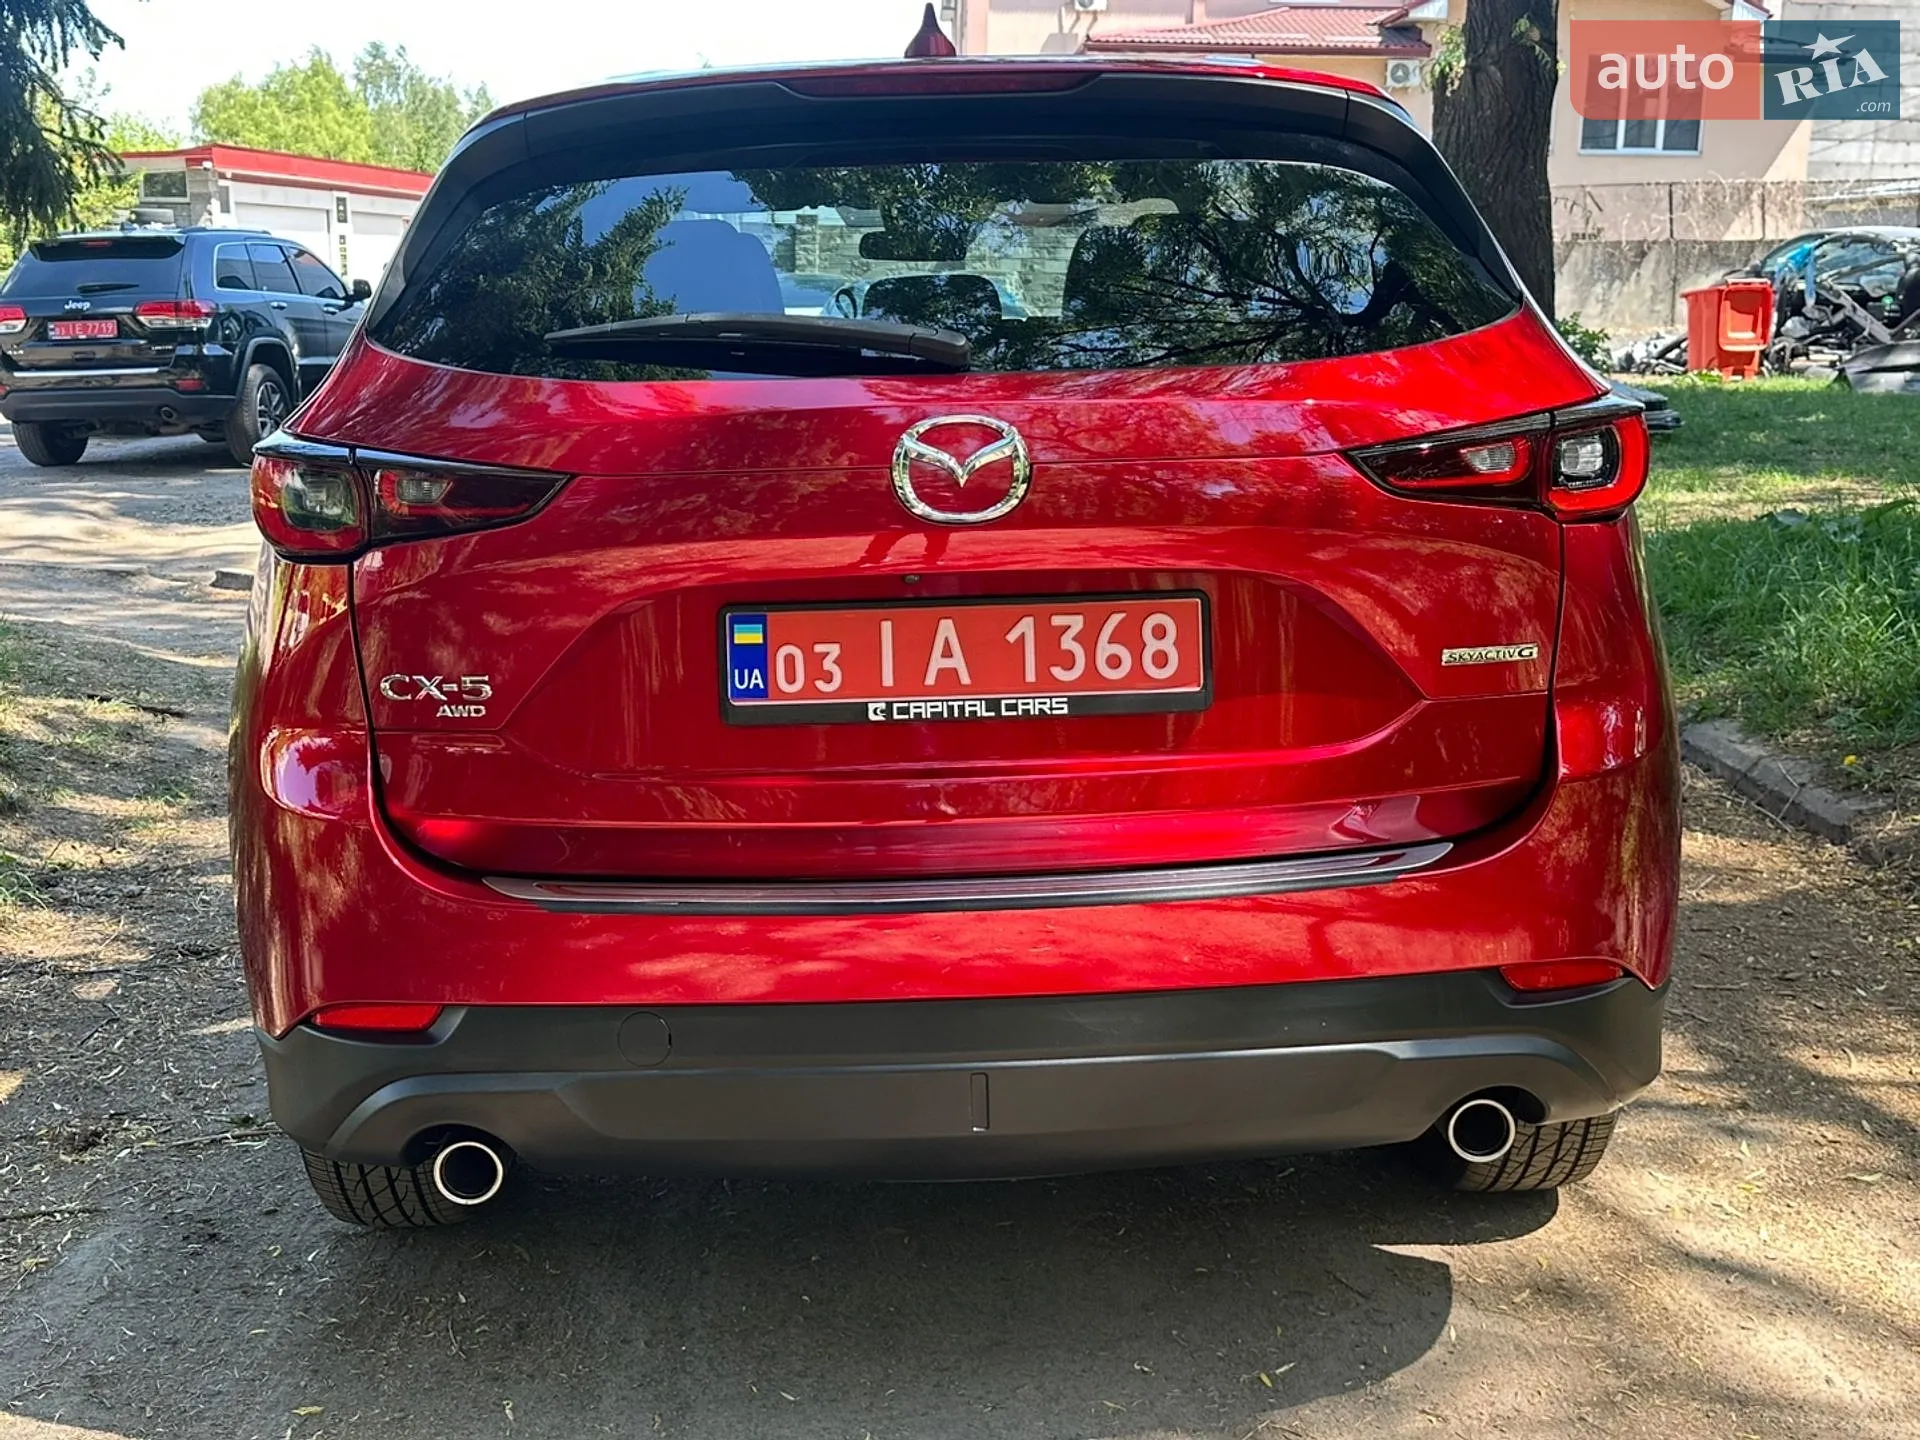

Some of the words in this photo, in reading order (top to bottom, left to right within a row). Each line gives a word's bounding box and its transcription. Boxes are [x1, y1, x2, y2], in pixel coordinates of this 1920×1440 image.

[64, 300, 91, 311] Jeep
[775, 643, 842, 694] 03
[880, 618, 972, 688] IA
[1005, 612, 1180, 683] 1368
[380, 673, 493, 701] CX-5
[733, 669, 765, 690] UA
[436, 704, 486, 718] AWD
[893, 702, 994, 720] CAPITAL
[1000, 698, 1069, 717] CARS
